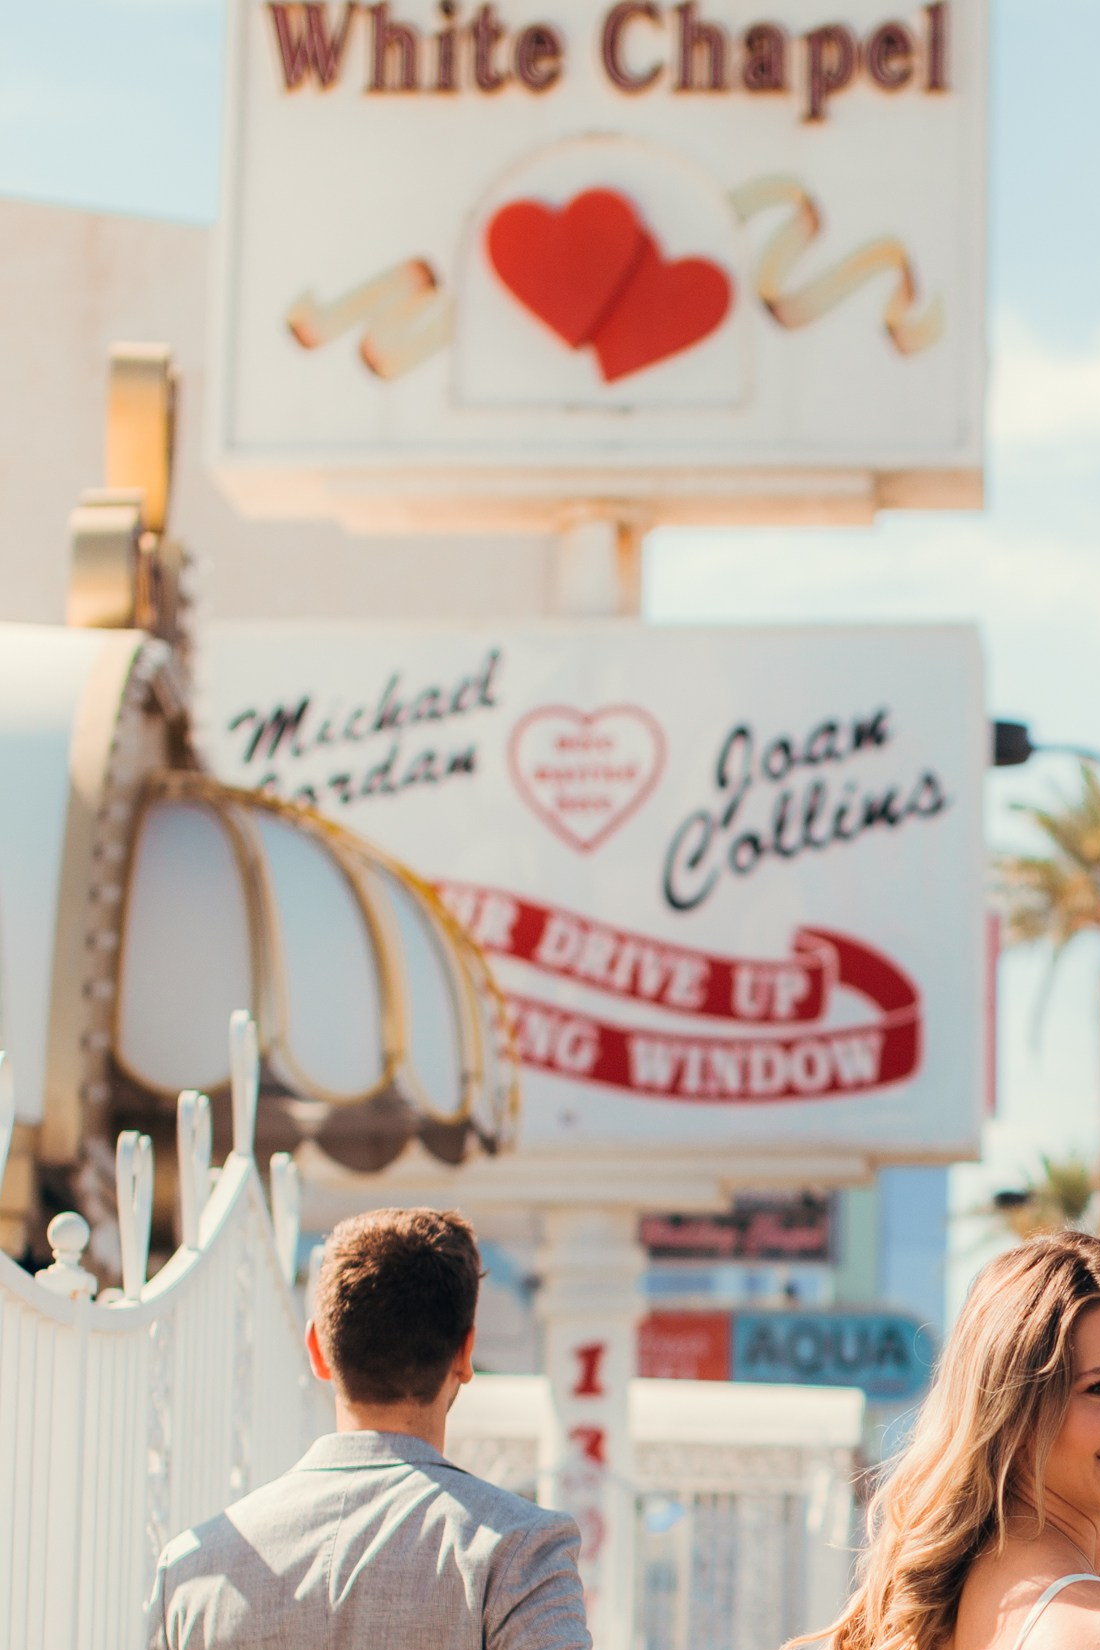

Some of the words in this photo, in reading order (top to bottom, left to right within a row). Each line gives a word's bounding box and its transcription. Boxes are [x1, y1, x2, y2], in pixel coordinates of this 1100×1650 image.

[268, 0, 563, 94] White
[598, 0, 949, 124] Chapel
[226, 645, 502, 764] Michael
[256, 740, 478, 805] ordan
[715, 703, 891, 829] Joan
[662, 770, 951, 912] Collins
[536, 915, 711, 1012] DRIVE
[730, 962, 813, 1022] UP
[628, 1030, 886, 1094] WINDOW
[744, 1318, 911, 1377] AQUA
